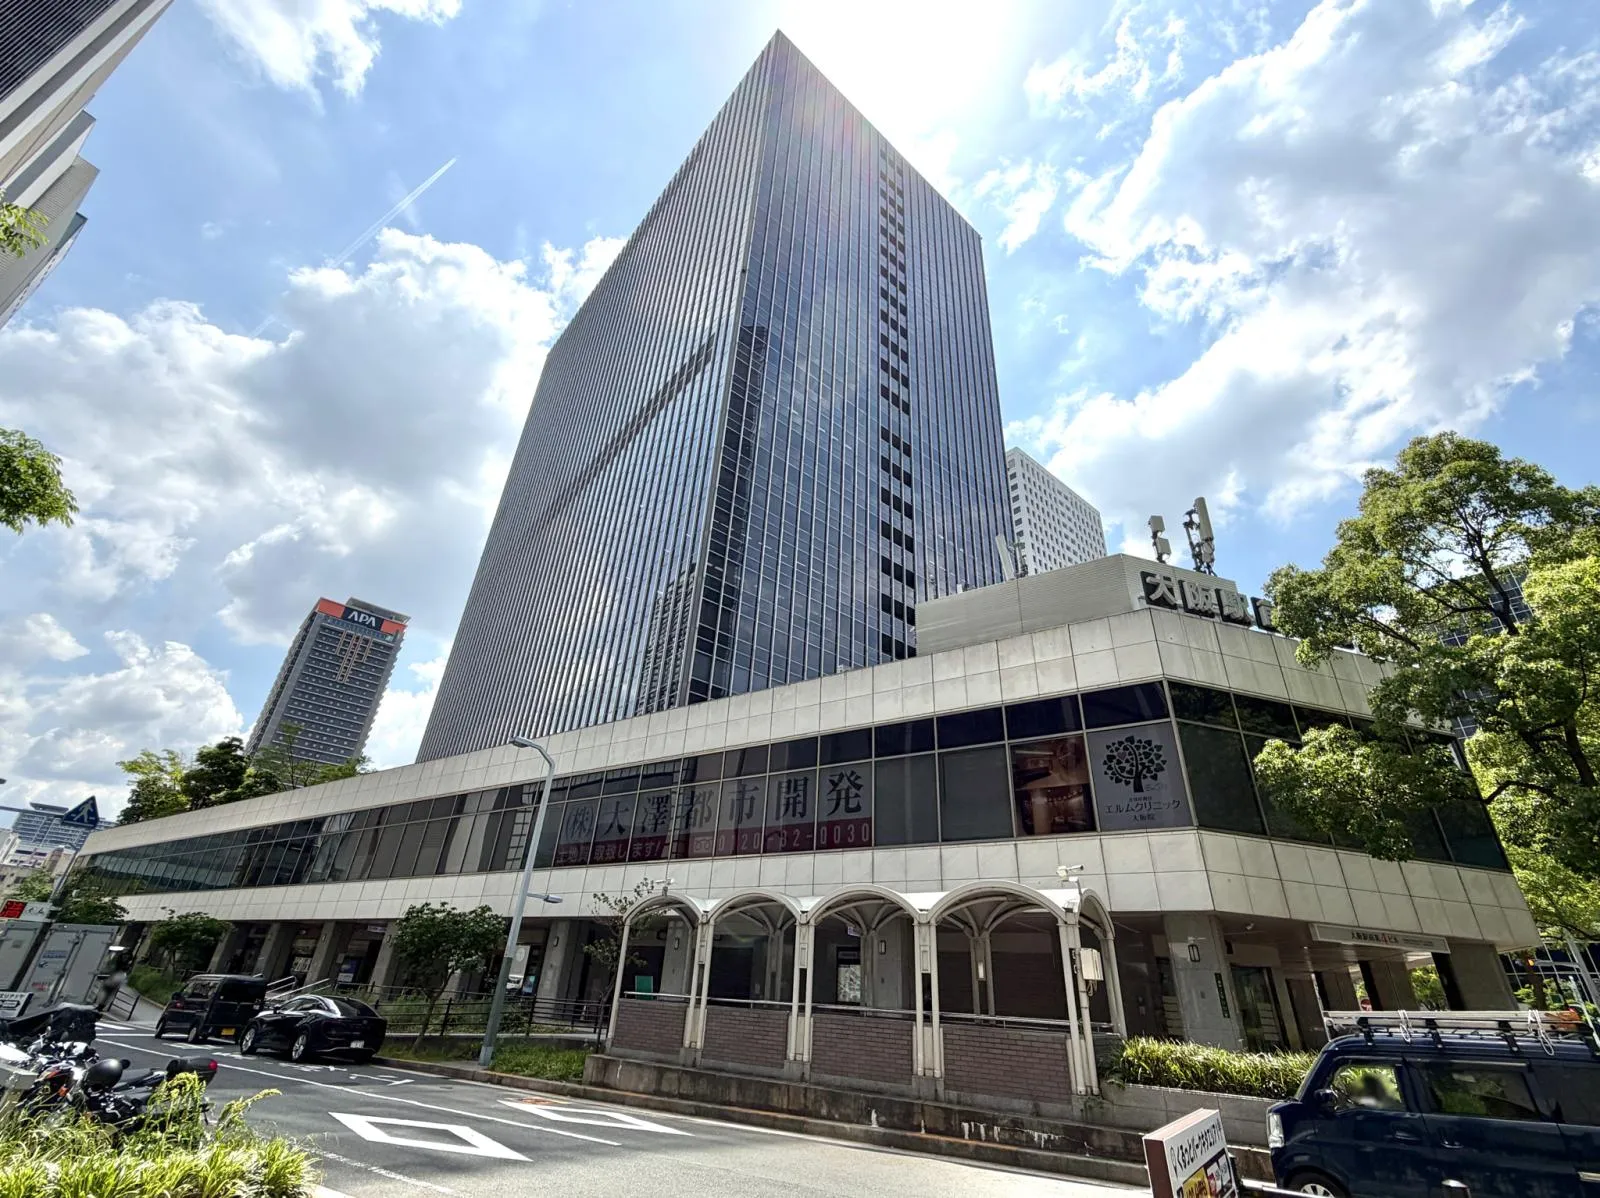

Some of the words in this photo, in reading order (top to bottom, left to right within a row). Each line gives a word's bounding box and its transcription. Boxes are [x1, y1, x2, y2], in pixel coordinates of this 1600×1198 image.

[348, 611, 376, 627] APA
[1105, 799, 1181, 814] エルムクリニック
